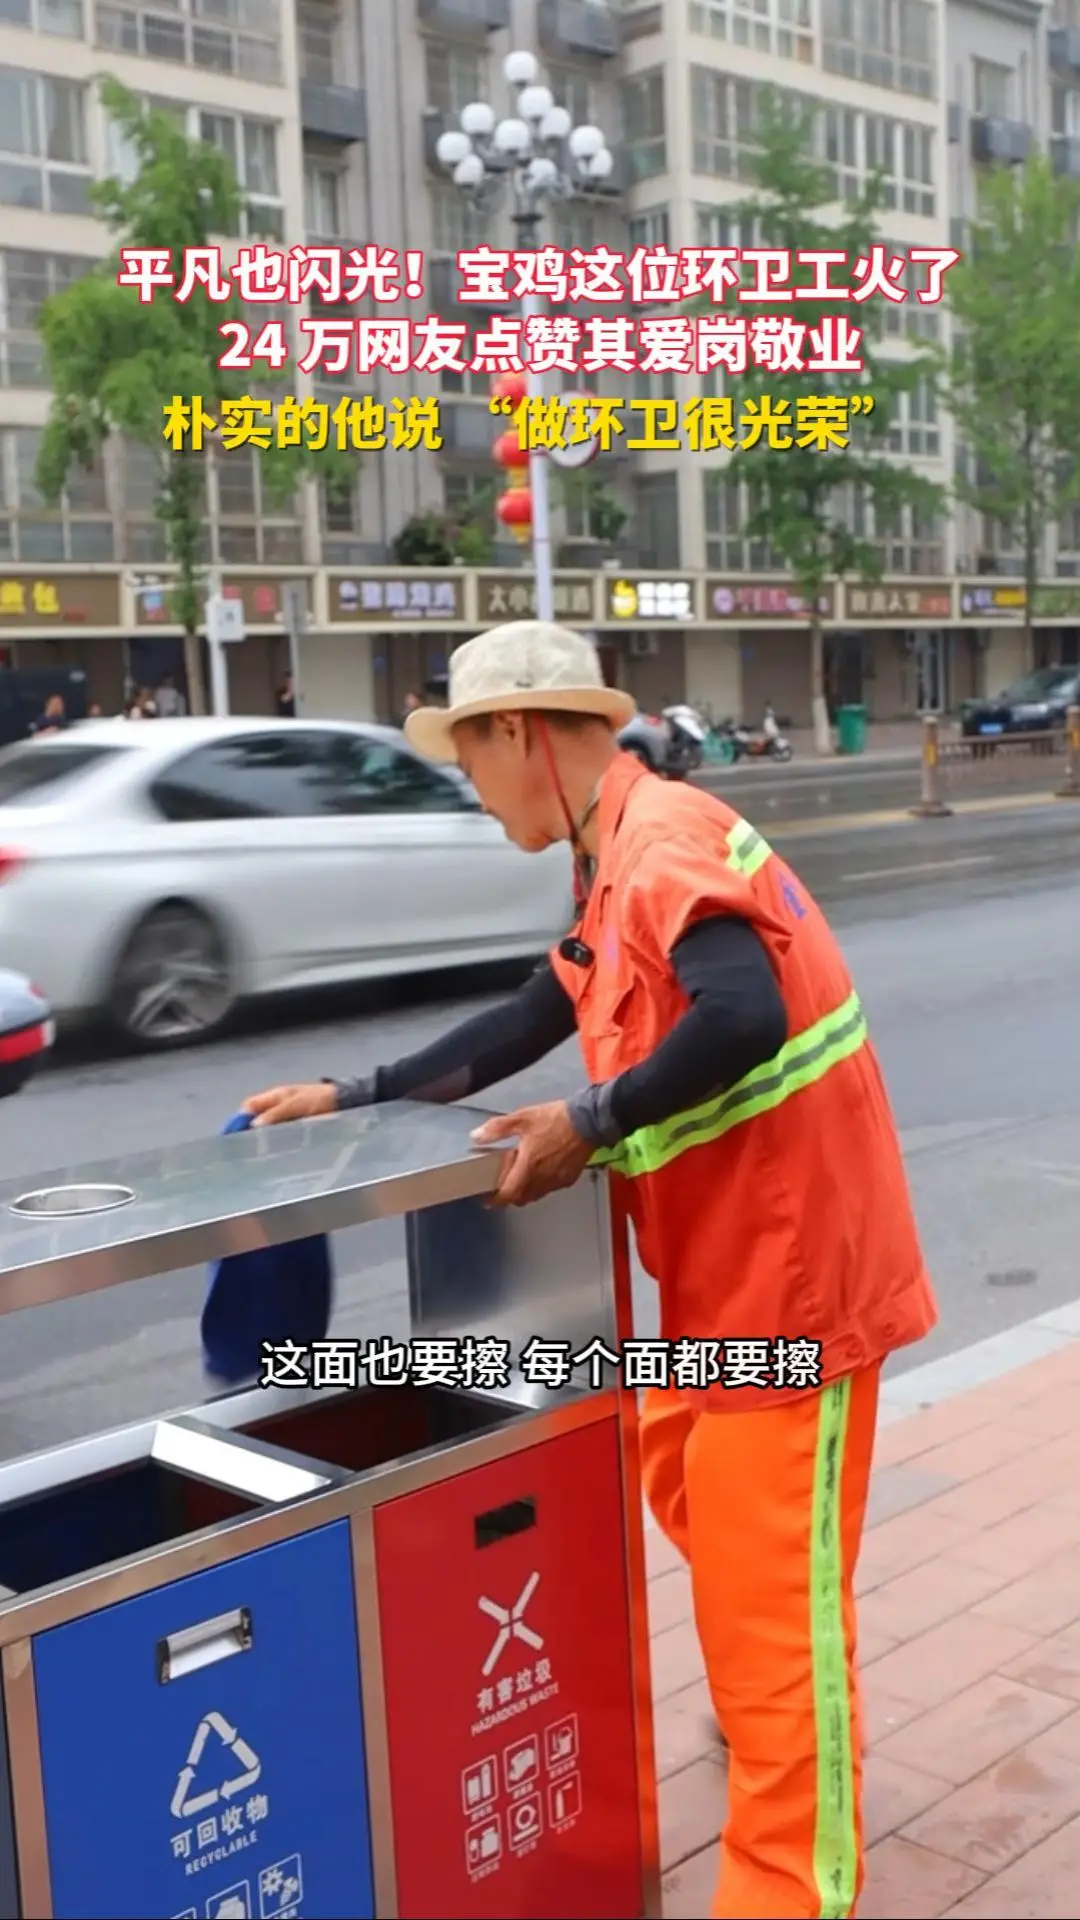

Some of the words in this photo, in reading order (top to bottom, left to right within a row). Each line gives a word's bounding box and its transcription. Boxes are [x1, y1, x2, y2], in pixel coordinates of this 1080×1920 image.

[477, 1657, 553, 1714] 有害垃圾
[470, 1698, 528, 1736] HAZARDOUS
[170, 1794, 269, 1858] 可回收物
[184, 1829, 258, 1876] RECYCLABLE
